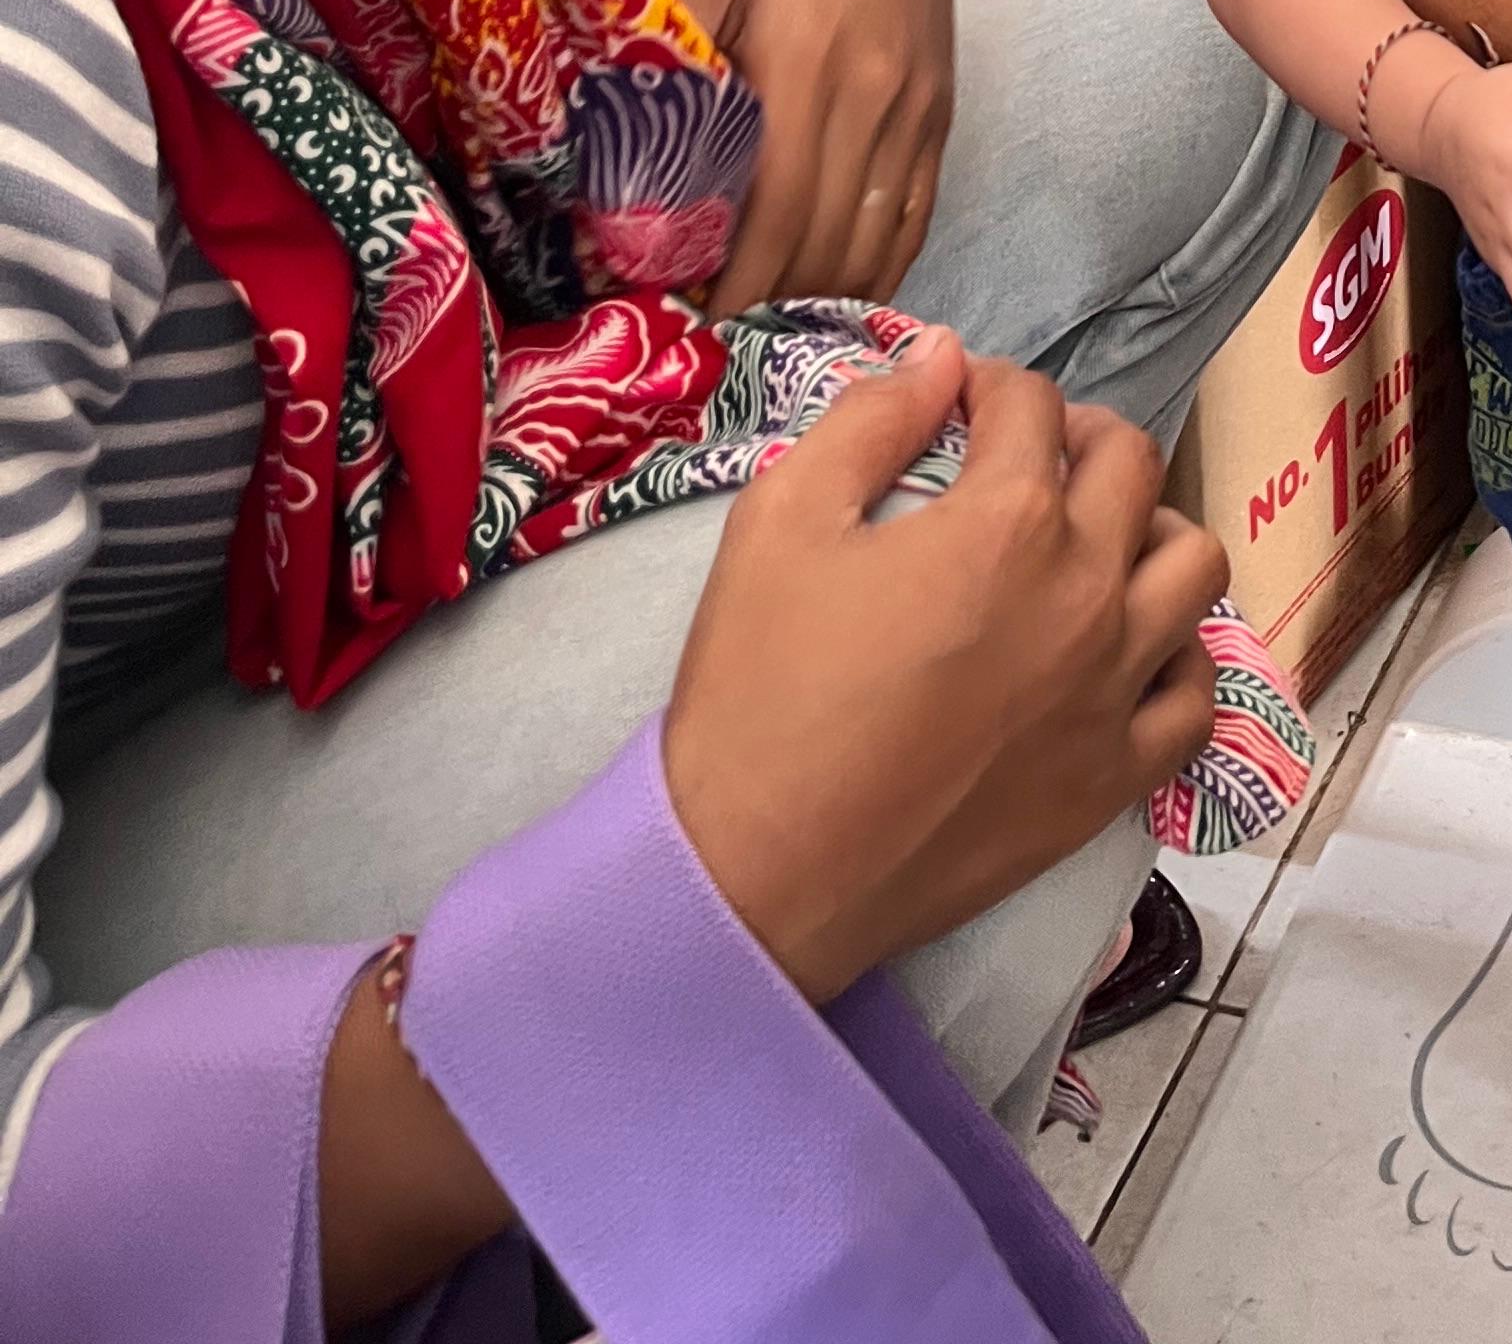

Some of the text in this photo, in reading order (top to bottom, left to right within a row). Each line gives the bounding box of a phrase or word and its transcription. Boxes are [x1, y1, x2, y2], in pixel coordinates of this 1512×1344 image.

[1311, 198, 1392, 356] SGM
[1249, 397, 1348, 544] NO. 1
